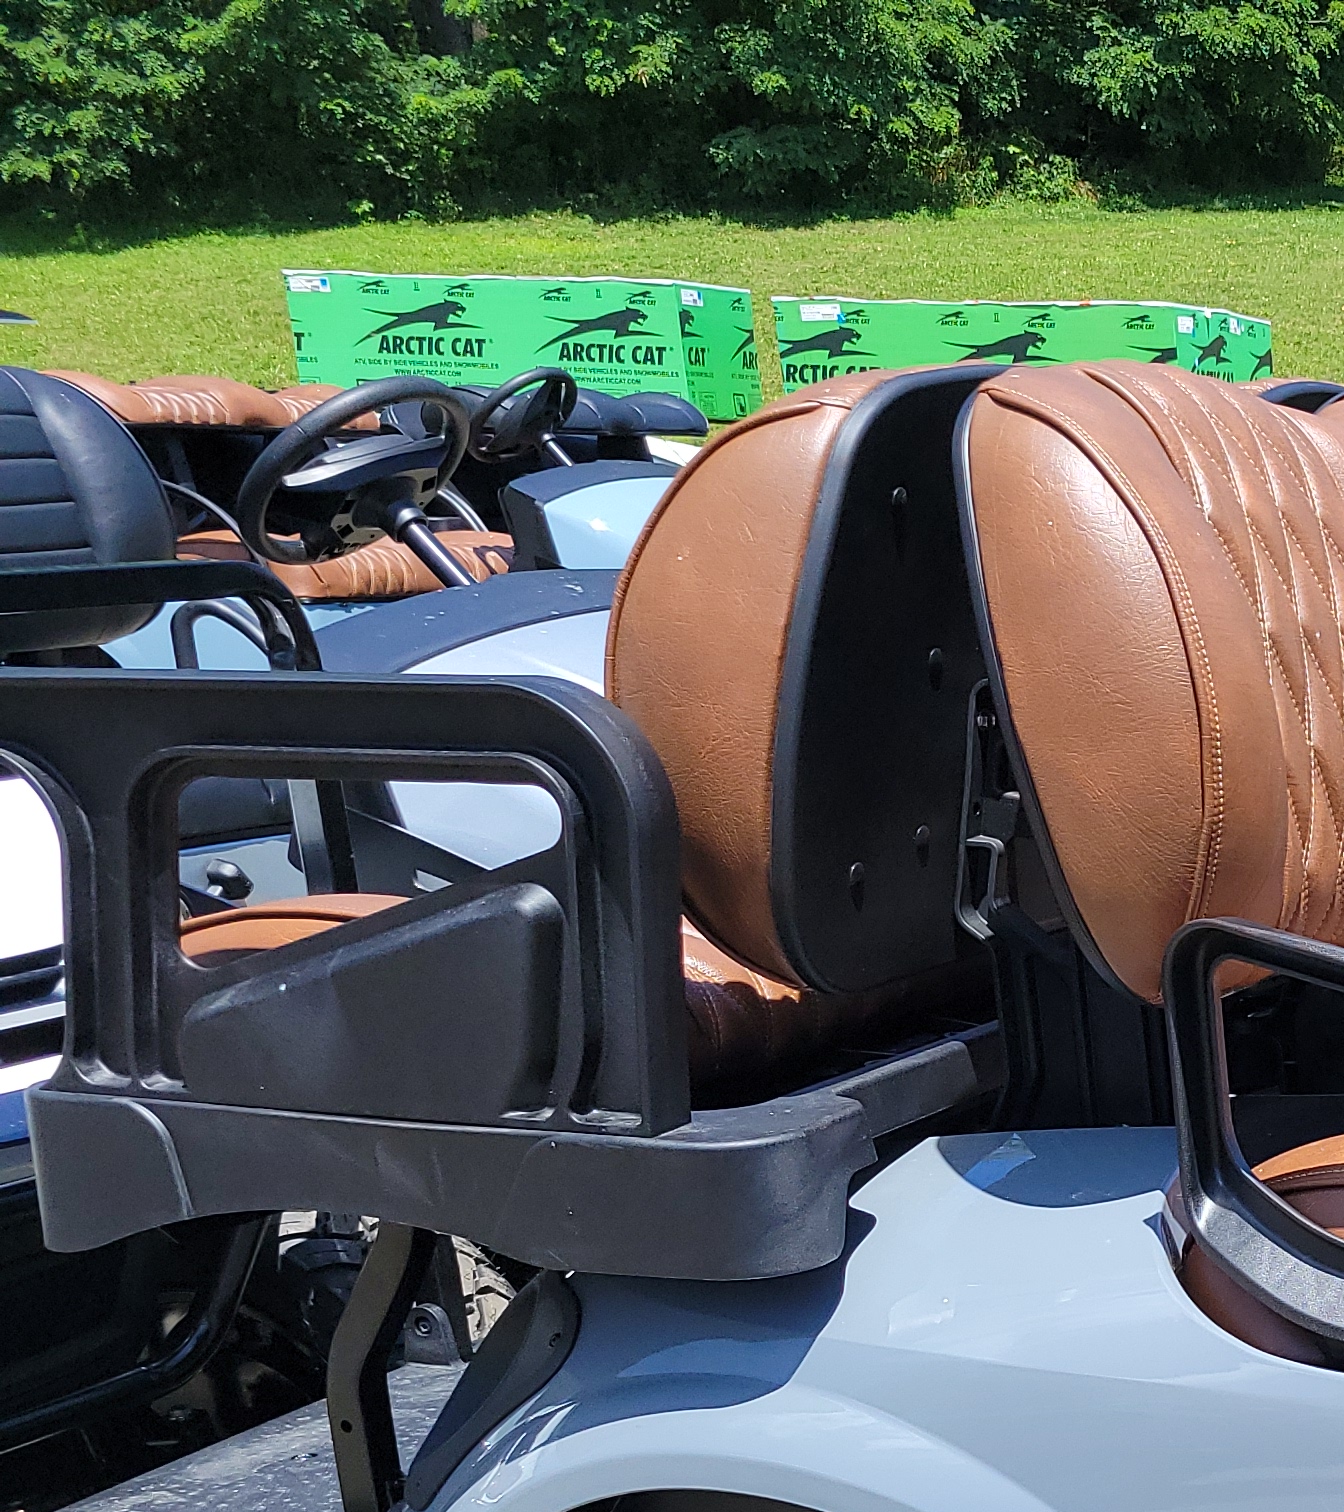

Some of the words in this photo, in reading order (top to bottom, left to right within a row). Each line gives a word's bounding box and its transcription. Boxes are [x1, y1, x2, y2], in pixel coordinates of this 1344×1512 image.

[378, 334, 445, 356] ARCTIC
[451, 337, 486, 358] CAT
[558, 342, 625, 364] ARCTIC
[631, 346, 667, 366] CAT
[688, 346, 706, 367] CAT
